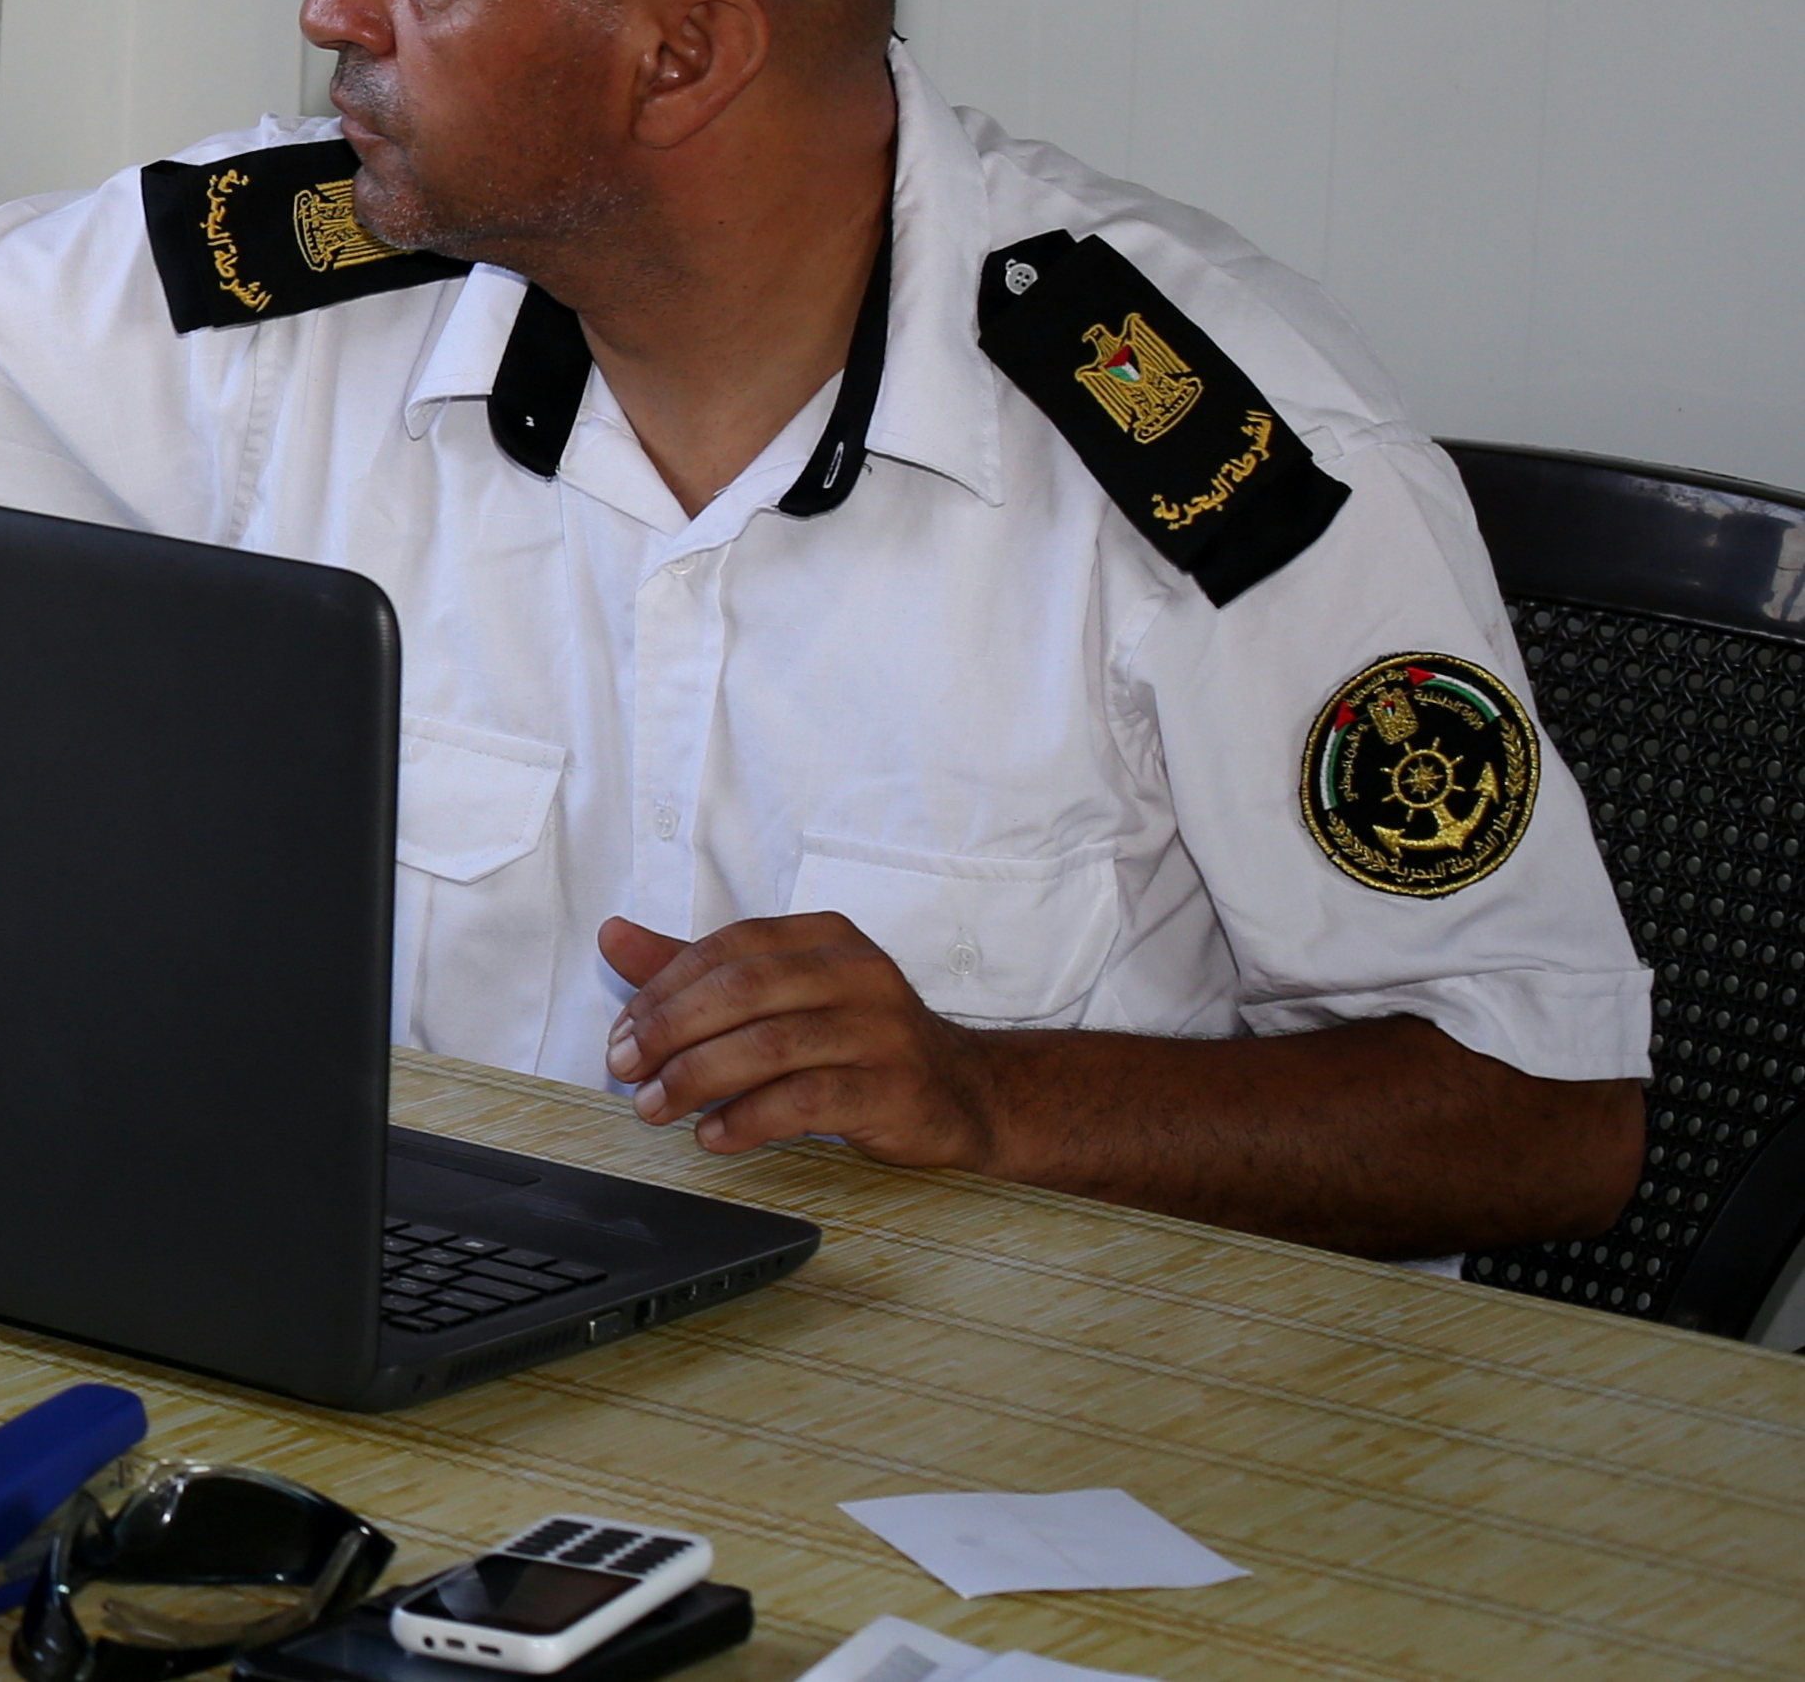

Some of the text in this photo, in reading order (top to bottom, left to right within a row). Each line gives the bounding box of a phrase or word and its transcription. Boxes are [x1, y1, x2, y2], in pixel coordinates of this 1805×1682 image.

[200, 169, 272, 313] الشرطة البحرية
[1152, 410, 1272, 530] الشرطة البحرية
[1390, 857, 1446, 884] البحرية
